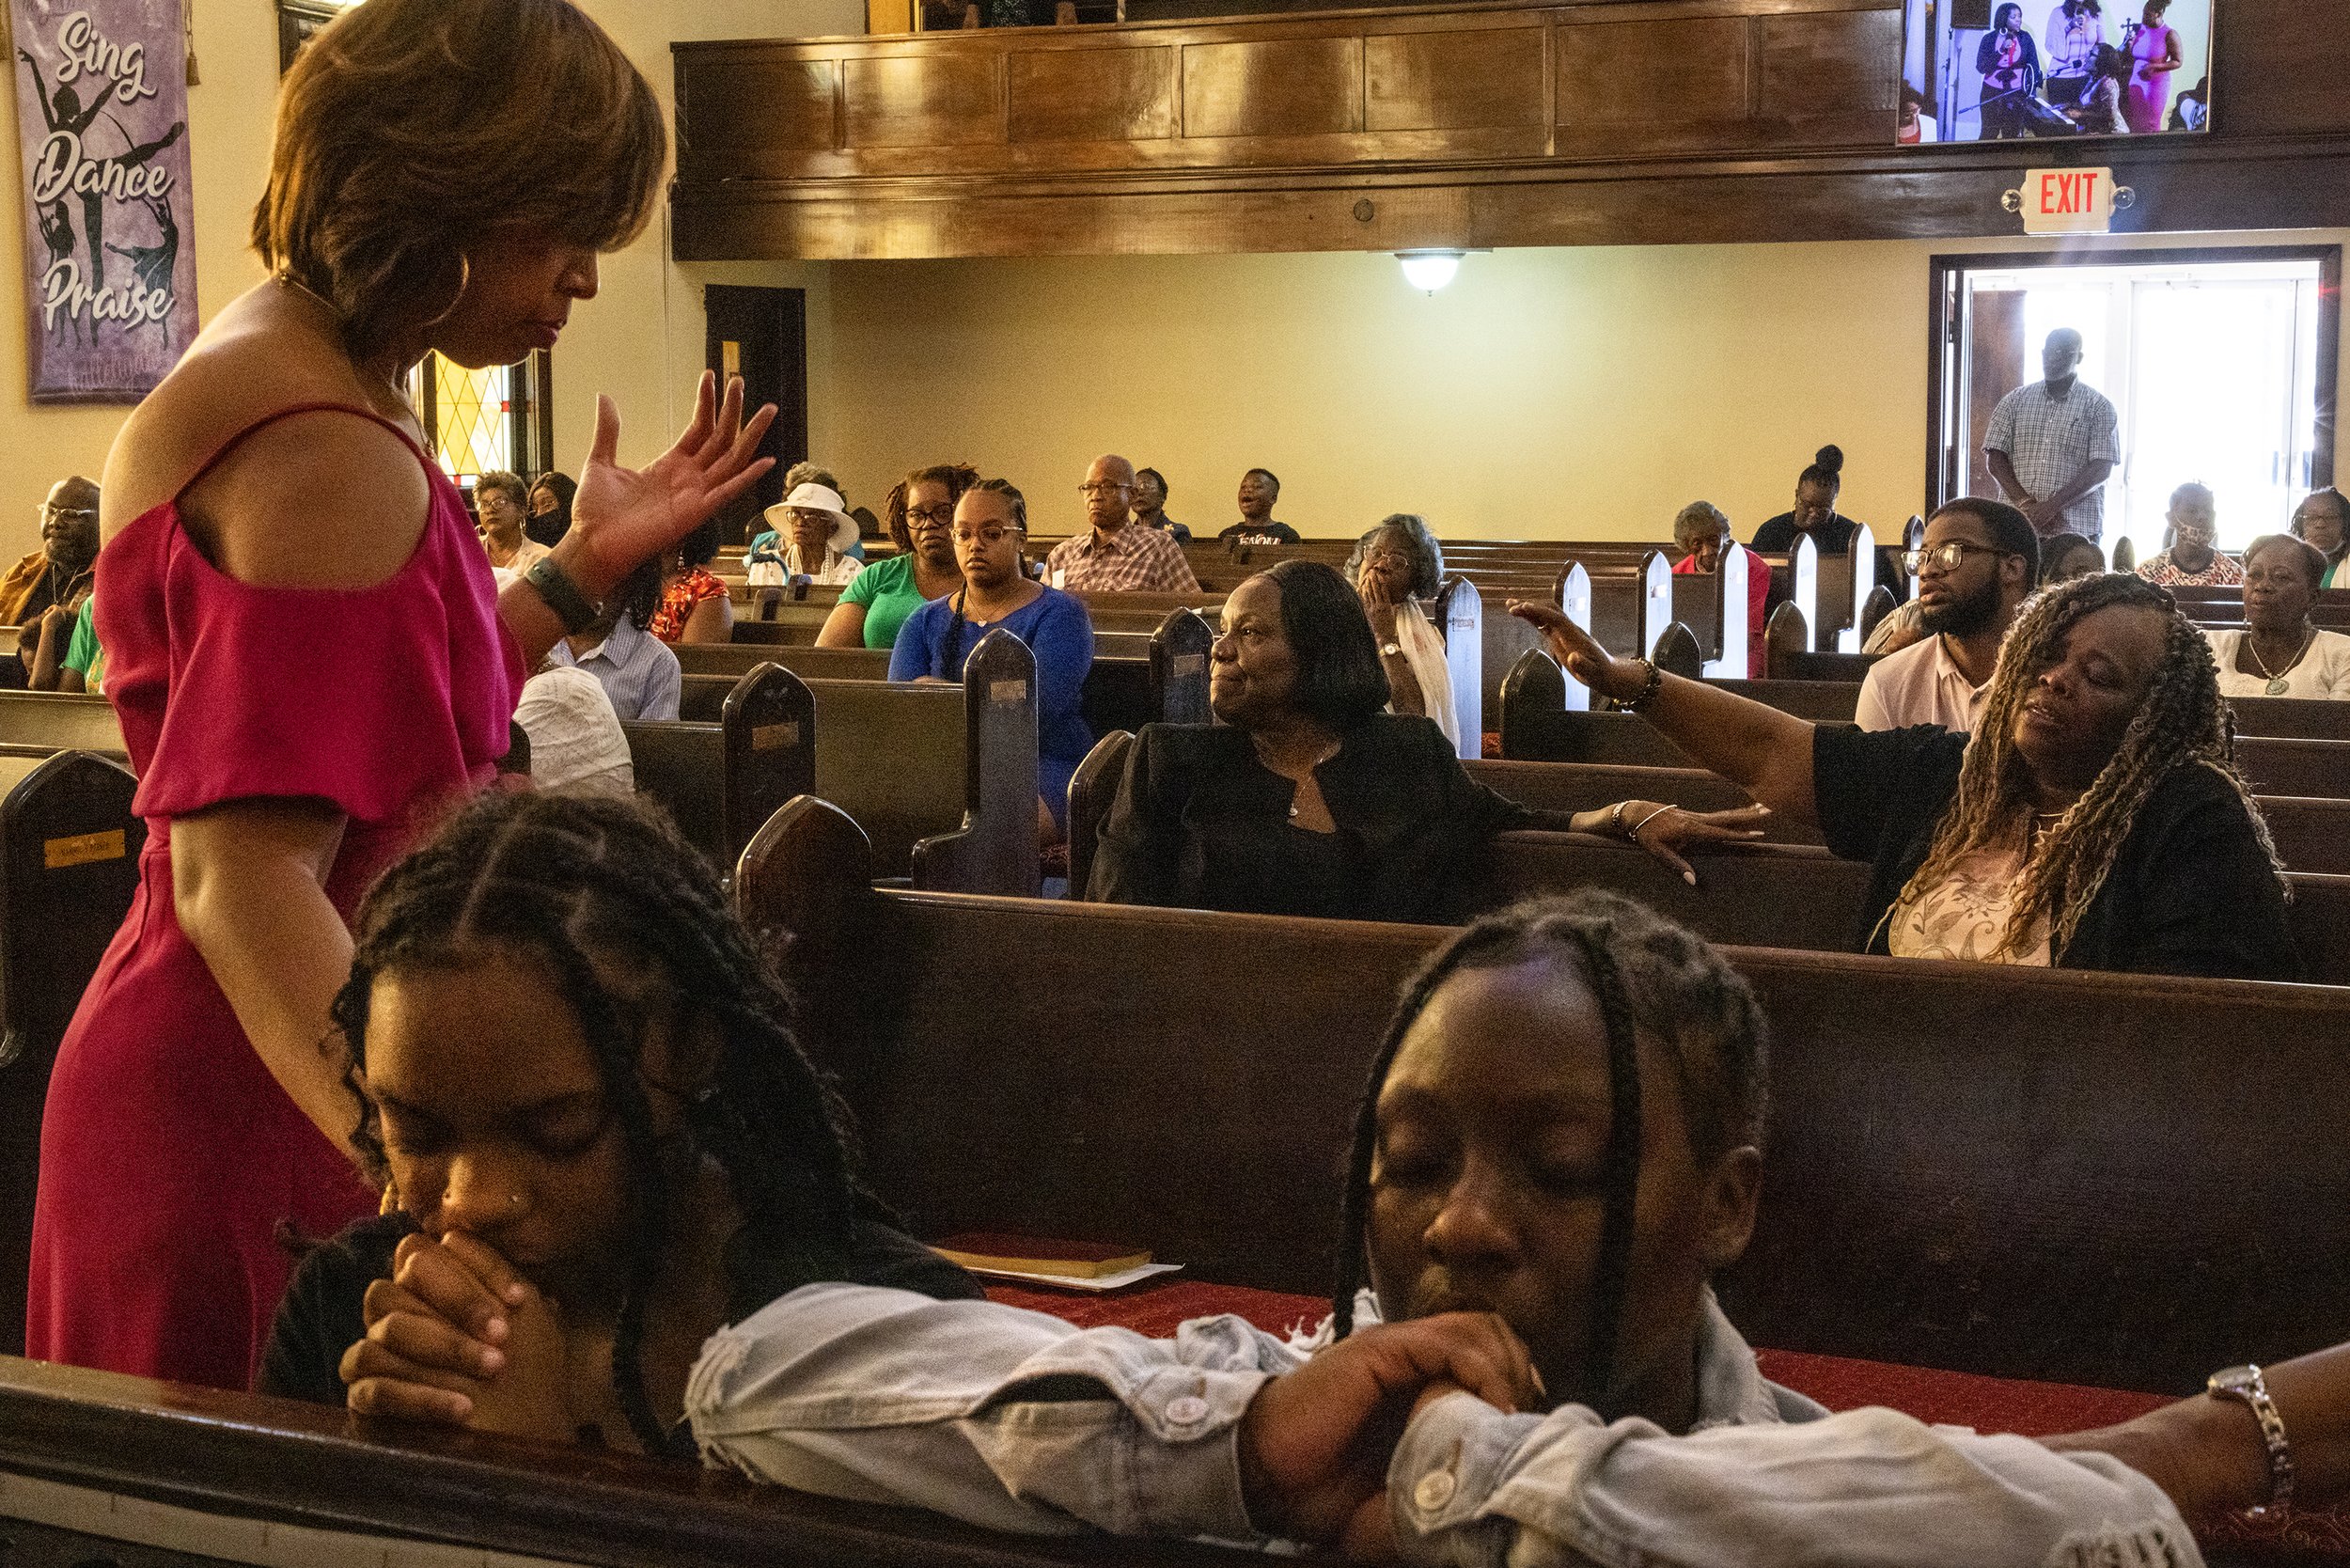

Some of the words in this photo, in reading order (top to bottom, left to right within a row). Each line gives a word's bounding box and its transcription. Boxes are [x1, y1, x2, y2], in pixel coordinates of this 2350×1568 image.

[56, 11, 156, 102] Sing
[34, 131, 173, 203] Dance
[2041, 173, 2097, 213] EXIT
[43, 259, 173, 331] Praise
